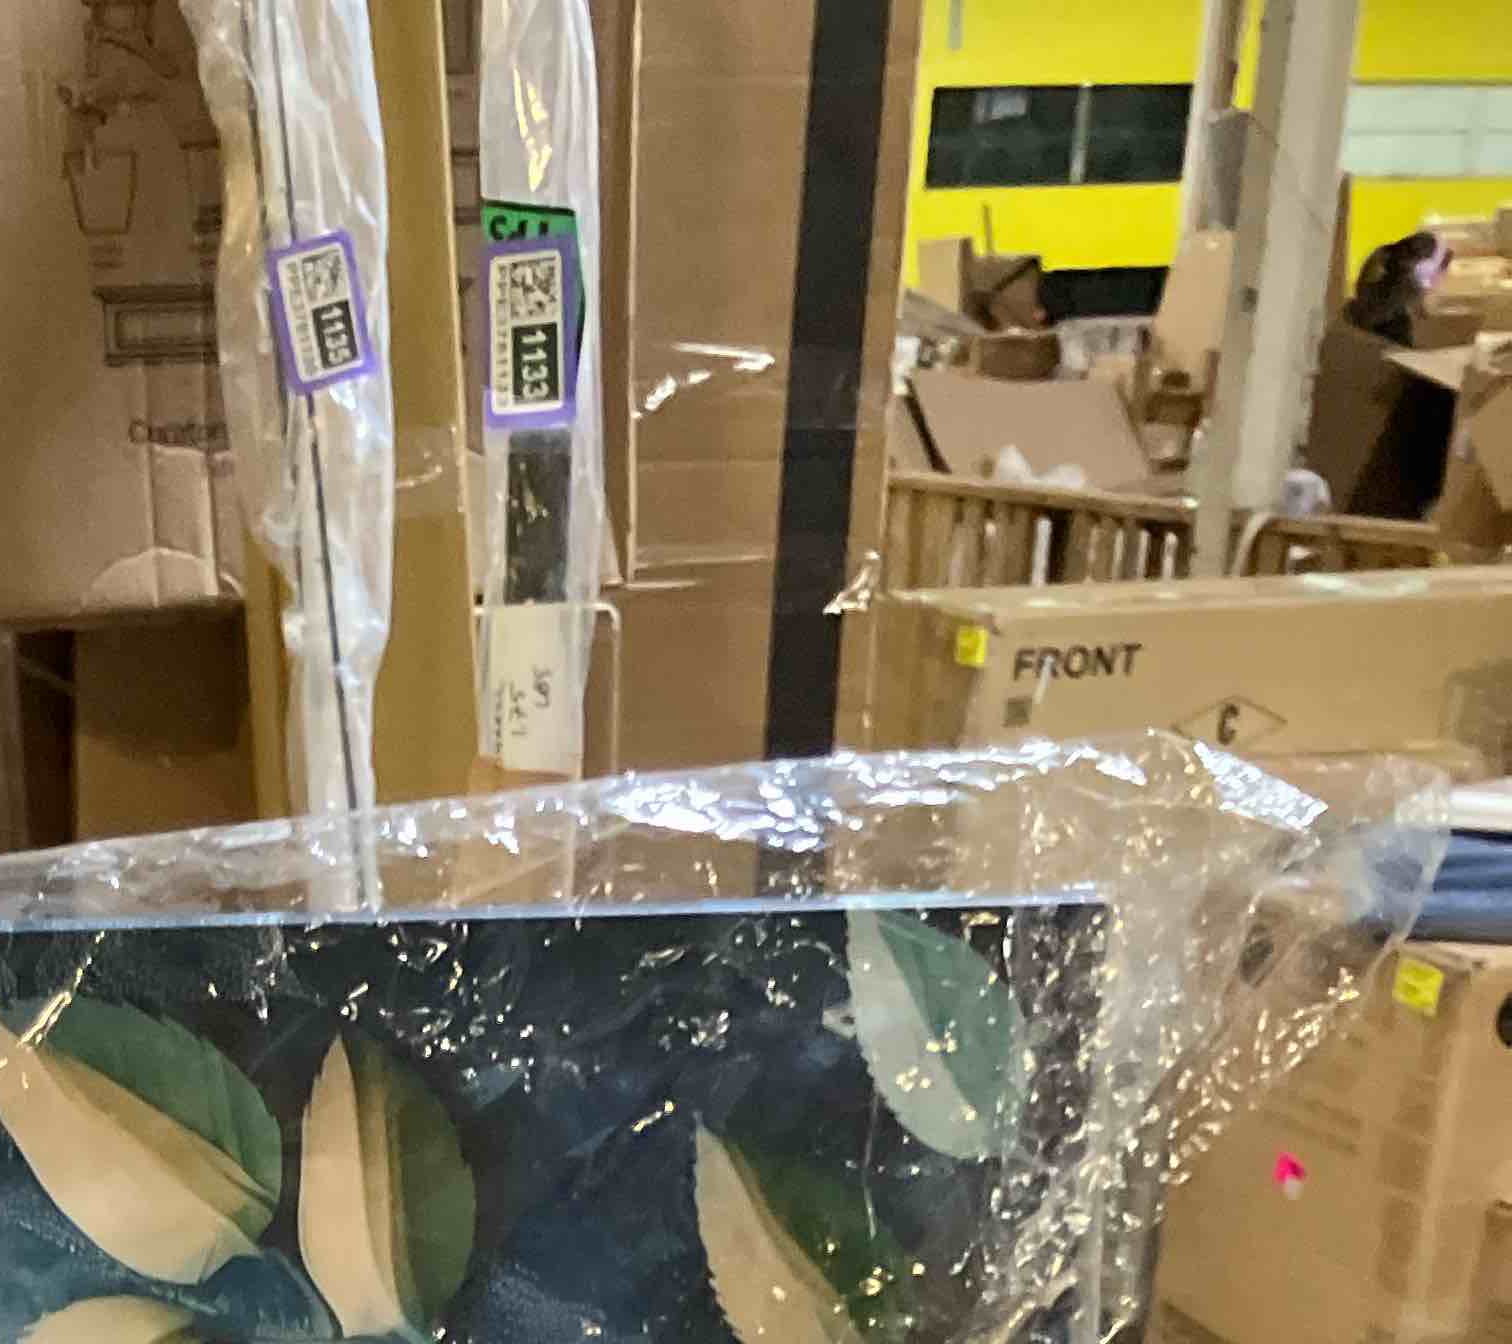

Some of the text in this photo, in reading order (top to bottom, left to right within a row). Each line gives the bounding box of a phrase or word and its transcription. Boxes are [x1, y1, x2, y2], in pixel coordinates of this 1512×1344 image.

[320, 306, 352, 366] 1135
[520, 329, 549, 399] 1133
[1014, 643, 1142, 681] FRONT
